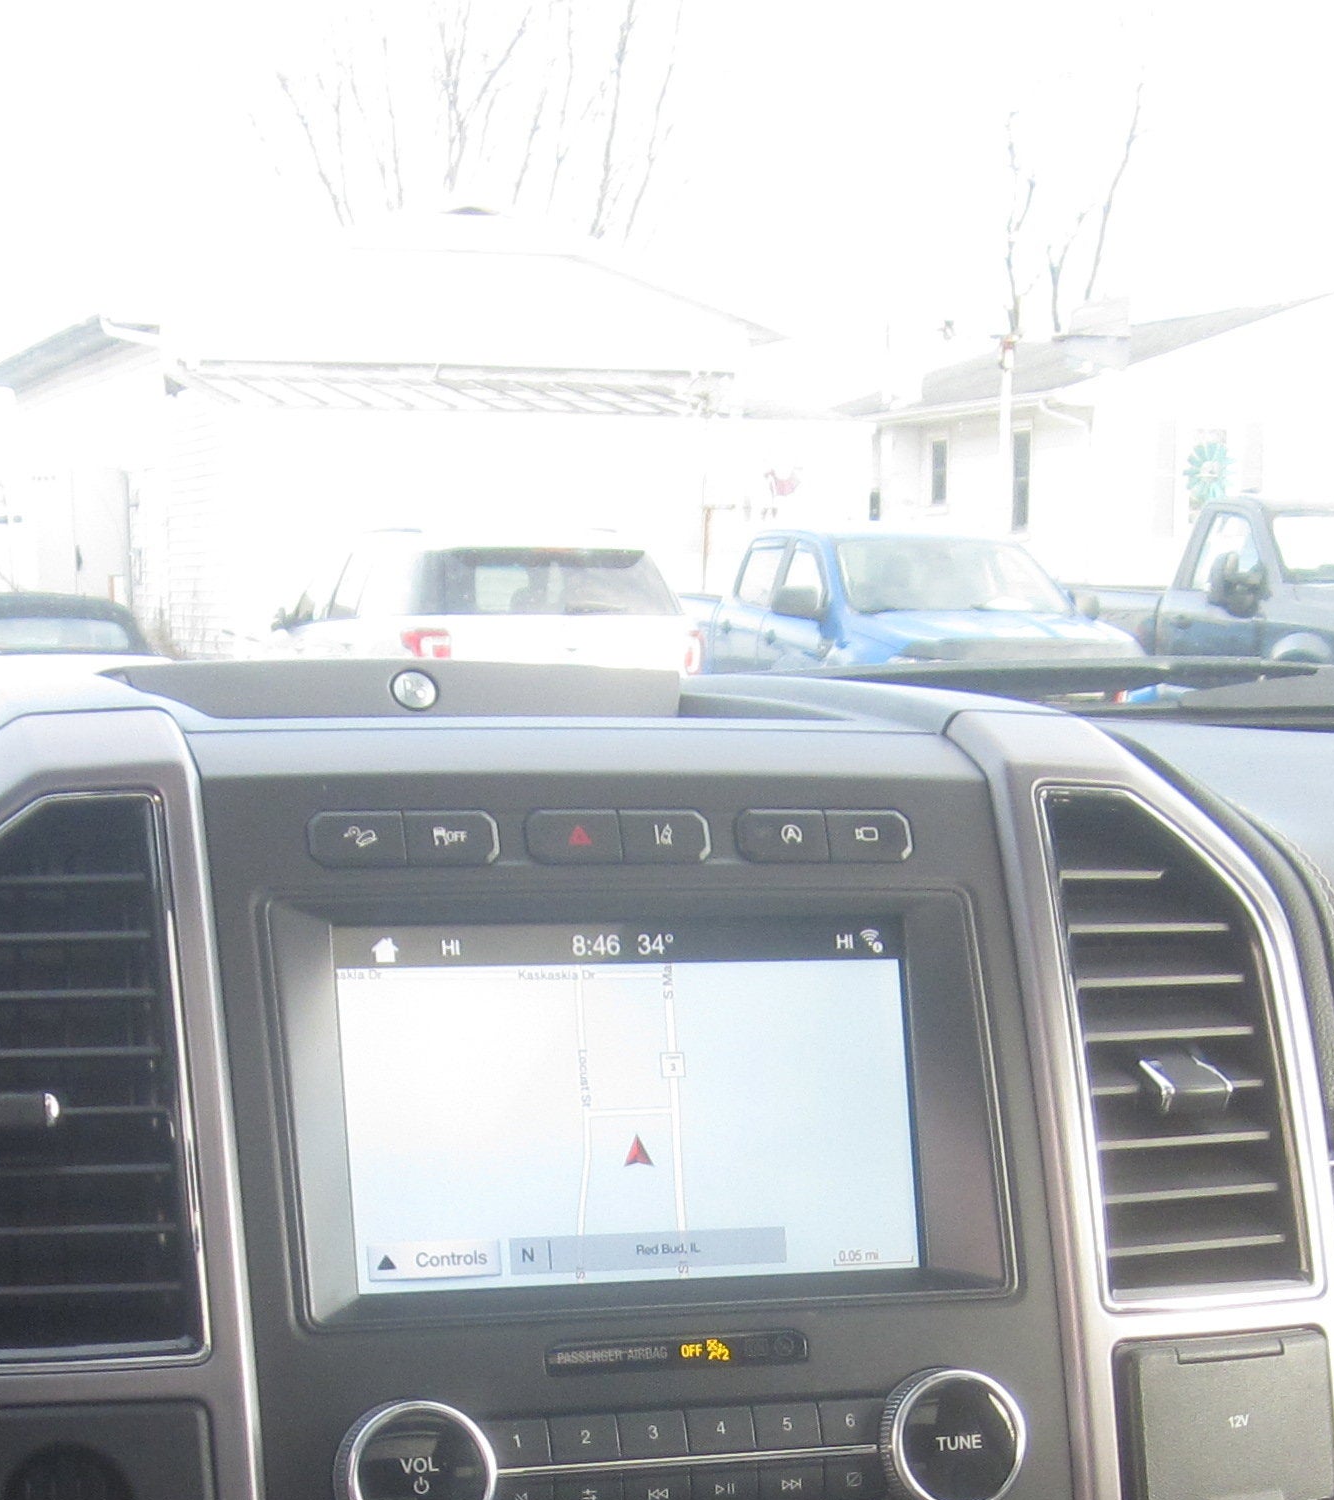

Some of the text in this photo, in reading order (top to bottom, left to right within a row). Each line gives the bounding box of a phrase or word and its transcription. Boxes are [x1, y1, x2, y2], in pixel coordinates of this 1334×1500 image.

[441, 938, 461, 956] HI
[571, 933, 621, 957] 8:46
[637, 932, 674, 956] 34°
[835, 933, 854, 950] HI
[521, 1246, 535, 1263] N
[636, 1242, 701, 1256] Red Bud, IL
[865, 1248, 879, 1262] mi
[415, 1249, 488, 1268] Controls
[556, 1346, 668, 1365] PASSENGER AIRBAG
[680, 1343, 703, 1358] OFF
[716, 1420, 726, 1434] 4
[782, 1416, 793, 1431] 5
[845, 1413, 855, 1427] 6
[1227, 1413, 1249, 1429] 12V
[580, 1429, 591, 1444] 2
[648, 1424, 659, 1439] 3
[513, 1433, 521, 1448] 1
[935, 1433, 983, 1452] TUNE
[399, 1456, 440, 1475] VOL
